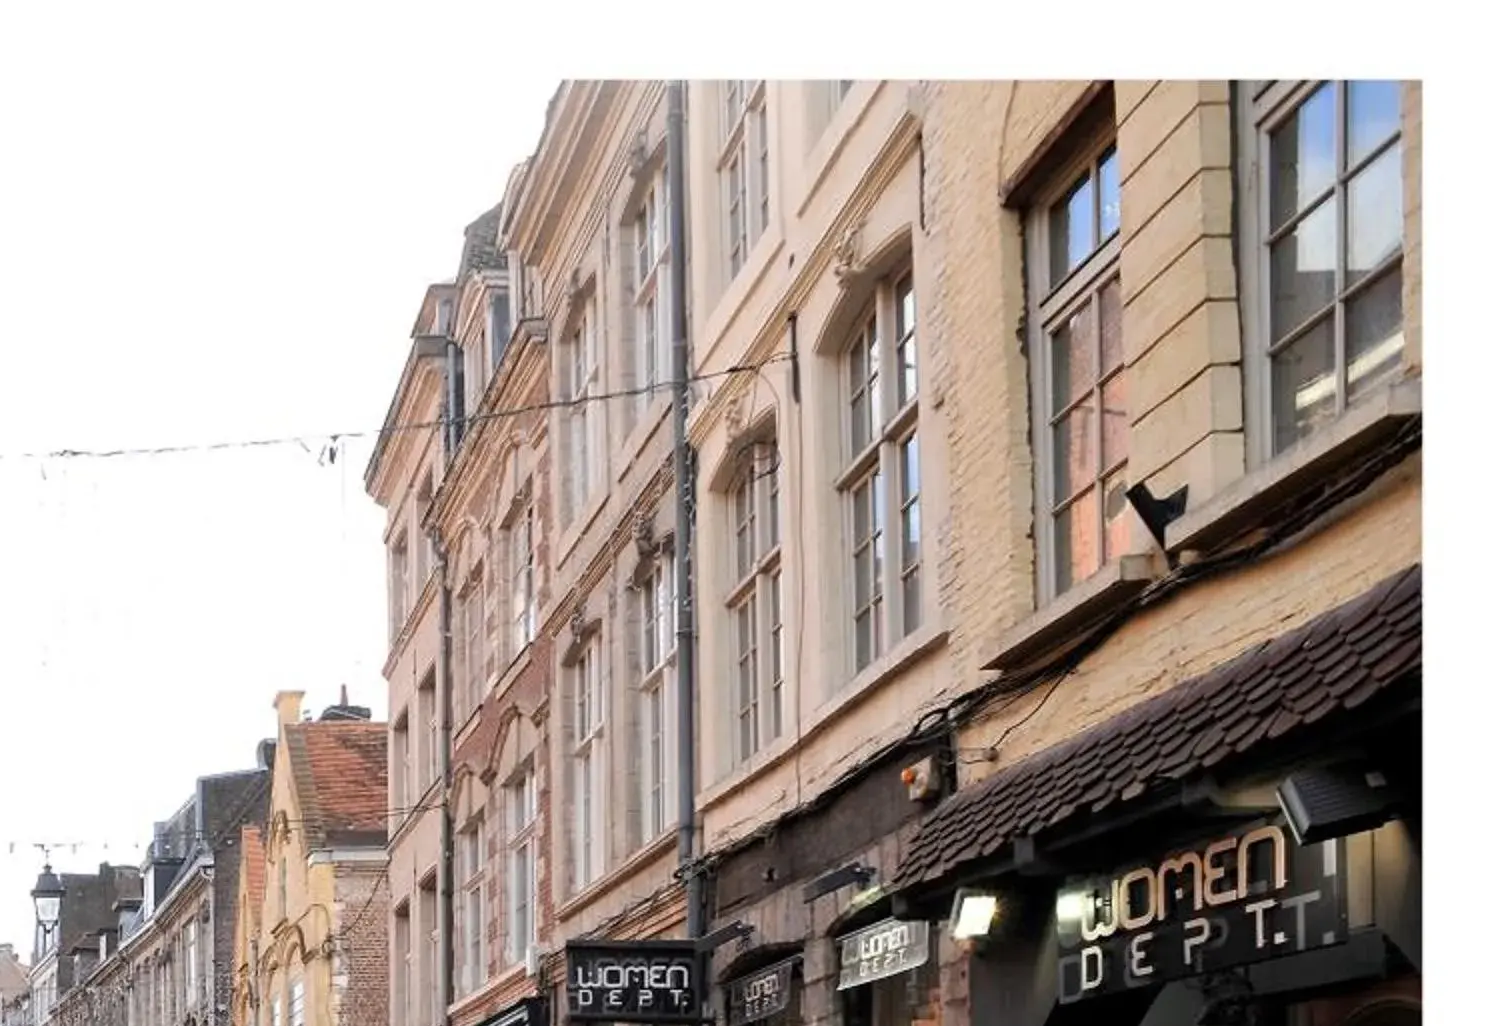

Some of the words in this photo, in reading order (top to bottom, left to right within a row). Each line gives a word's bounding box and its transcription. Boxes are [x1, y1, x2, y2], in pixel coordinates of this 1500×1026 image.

[1081, 825, 1288, 942] WOMEN
[860, 925, 909, 959] WOMEN
[577, 965, 689, 988] WOMEN
